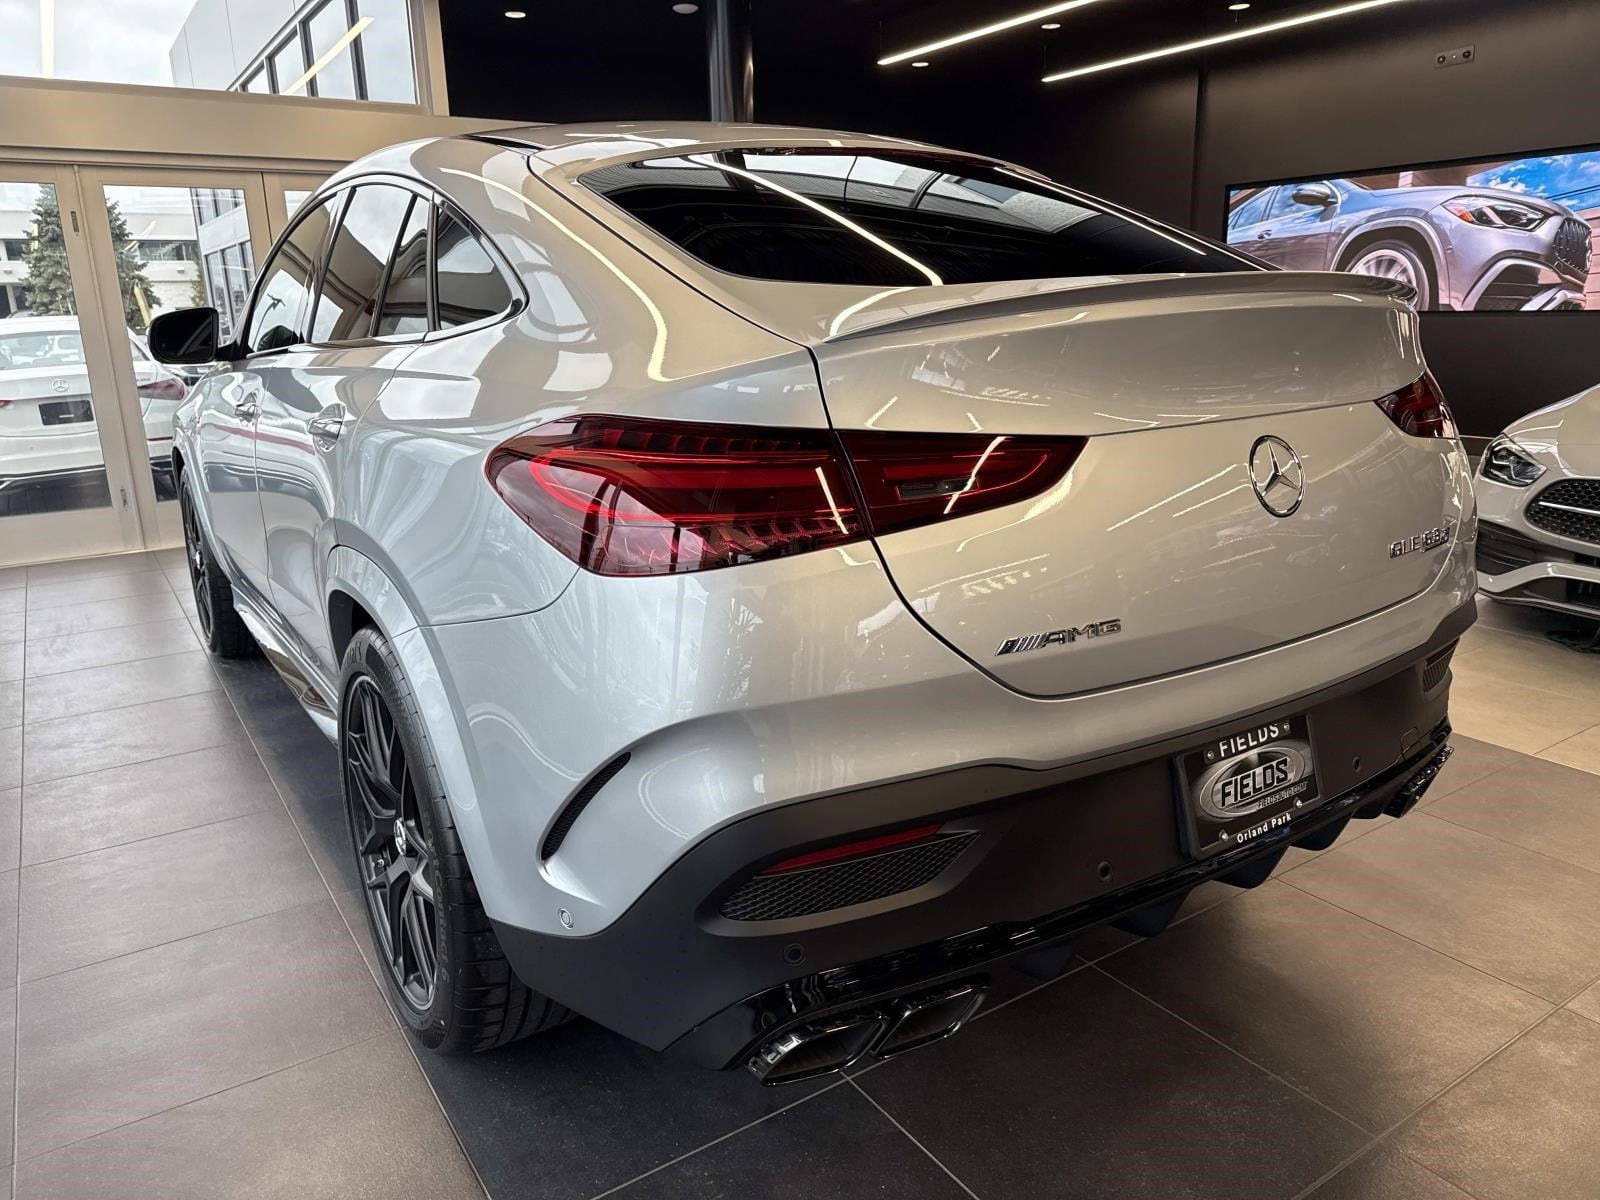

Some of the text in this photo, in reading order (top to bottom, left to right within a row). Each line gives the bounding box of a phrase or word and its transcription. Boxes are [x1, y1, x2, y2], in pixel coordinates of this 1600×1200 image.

[1389, 536, 1421, 558] GLE
[1040, 618, 1122, 648] AMG
[1219, 724, 1279, 757] FIELDS
[1221, 757, 1288, 807] FIELDS
[1237, 812, 1291, 843] Orland Park
